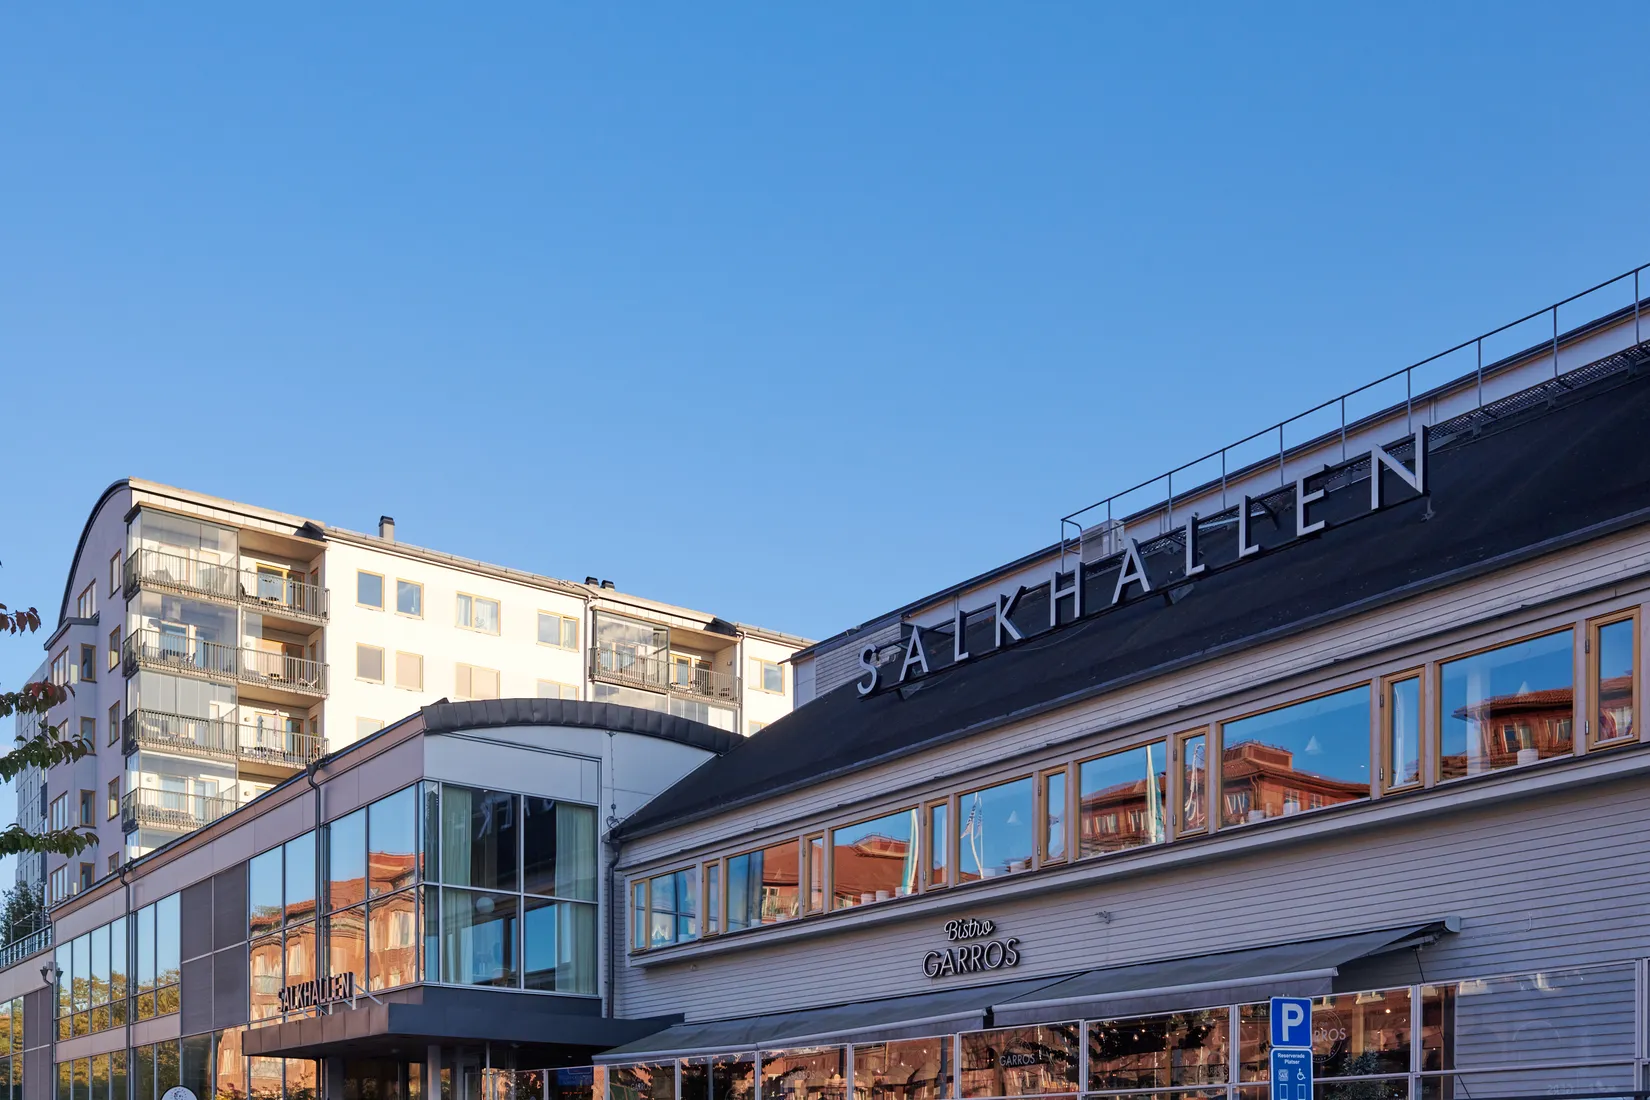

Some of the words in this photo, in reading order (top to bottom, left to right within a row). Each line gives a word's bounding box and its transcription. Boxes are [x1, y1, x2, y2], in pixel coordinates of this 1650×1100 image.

[857, 425, 1428, 694] SALKHALLEN
[944, 919, 994, 941] Bistro
[922, 938, 1019, 978] GARROS
[278, 972, 355, 1012] SALKHALLEN
[1281, 1003, 1304, 1041] P
[1000, 1053, 1035, 1066] GARROS
